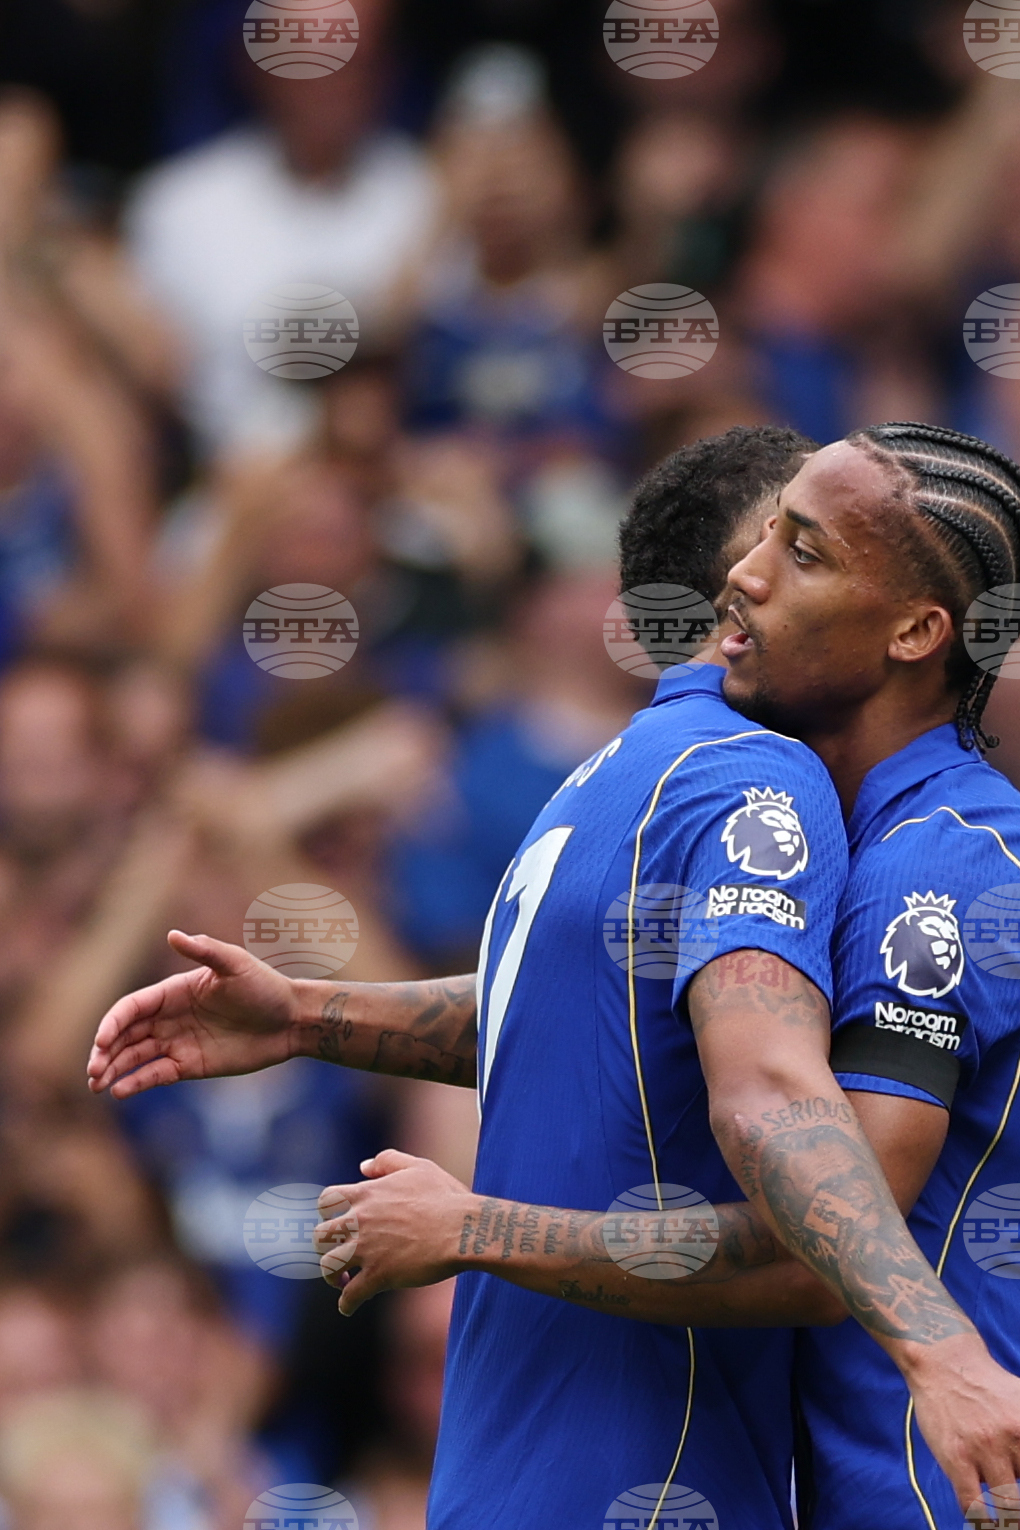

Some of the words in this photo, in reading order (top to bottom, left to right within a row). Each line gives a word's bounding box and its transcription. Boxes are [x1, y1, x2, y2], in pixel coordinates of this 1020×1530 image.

[708, 885, 738, 906] No
[741, 887, 796, 915] room
[738, 902, 805, 931] racism
[875, 1001, 907, 1023] No
[904, 1009, 957, 1034] room
